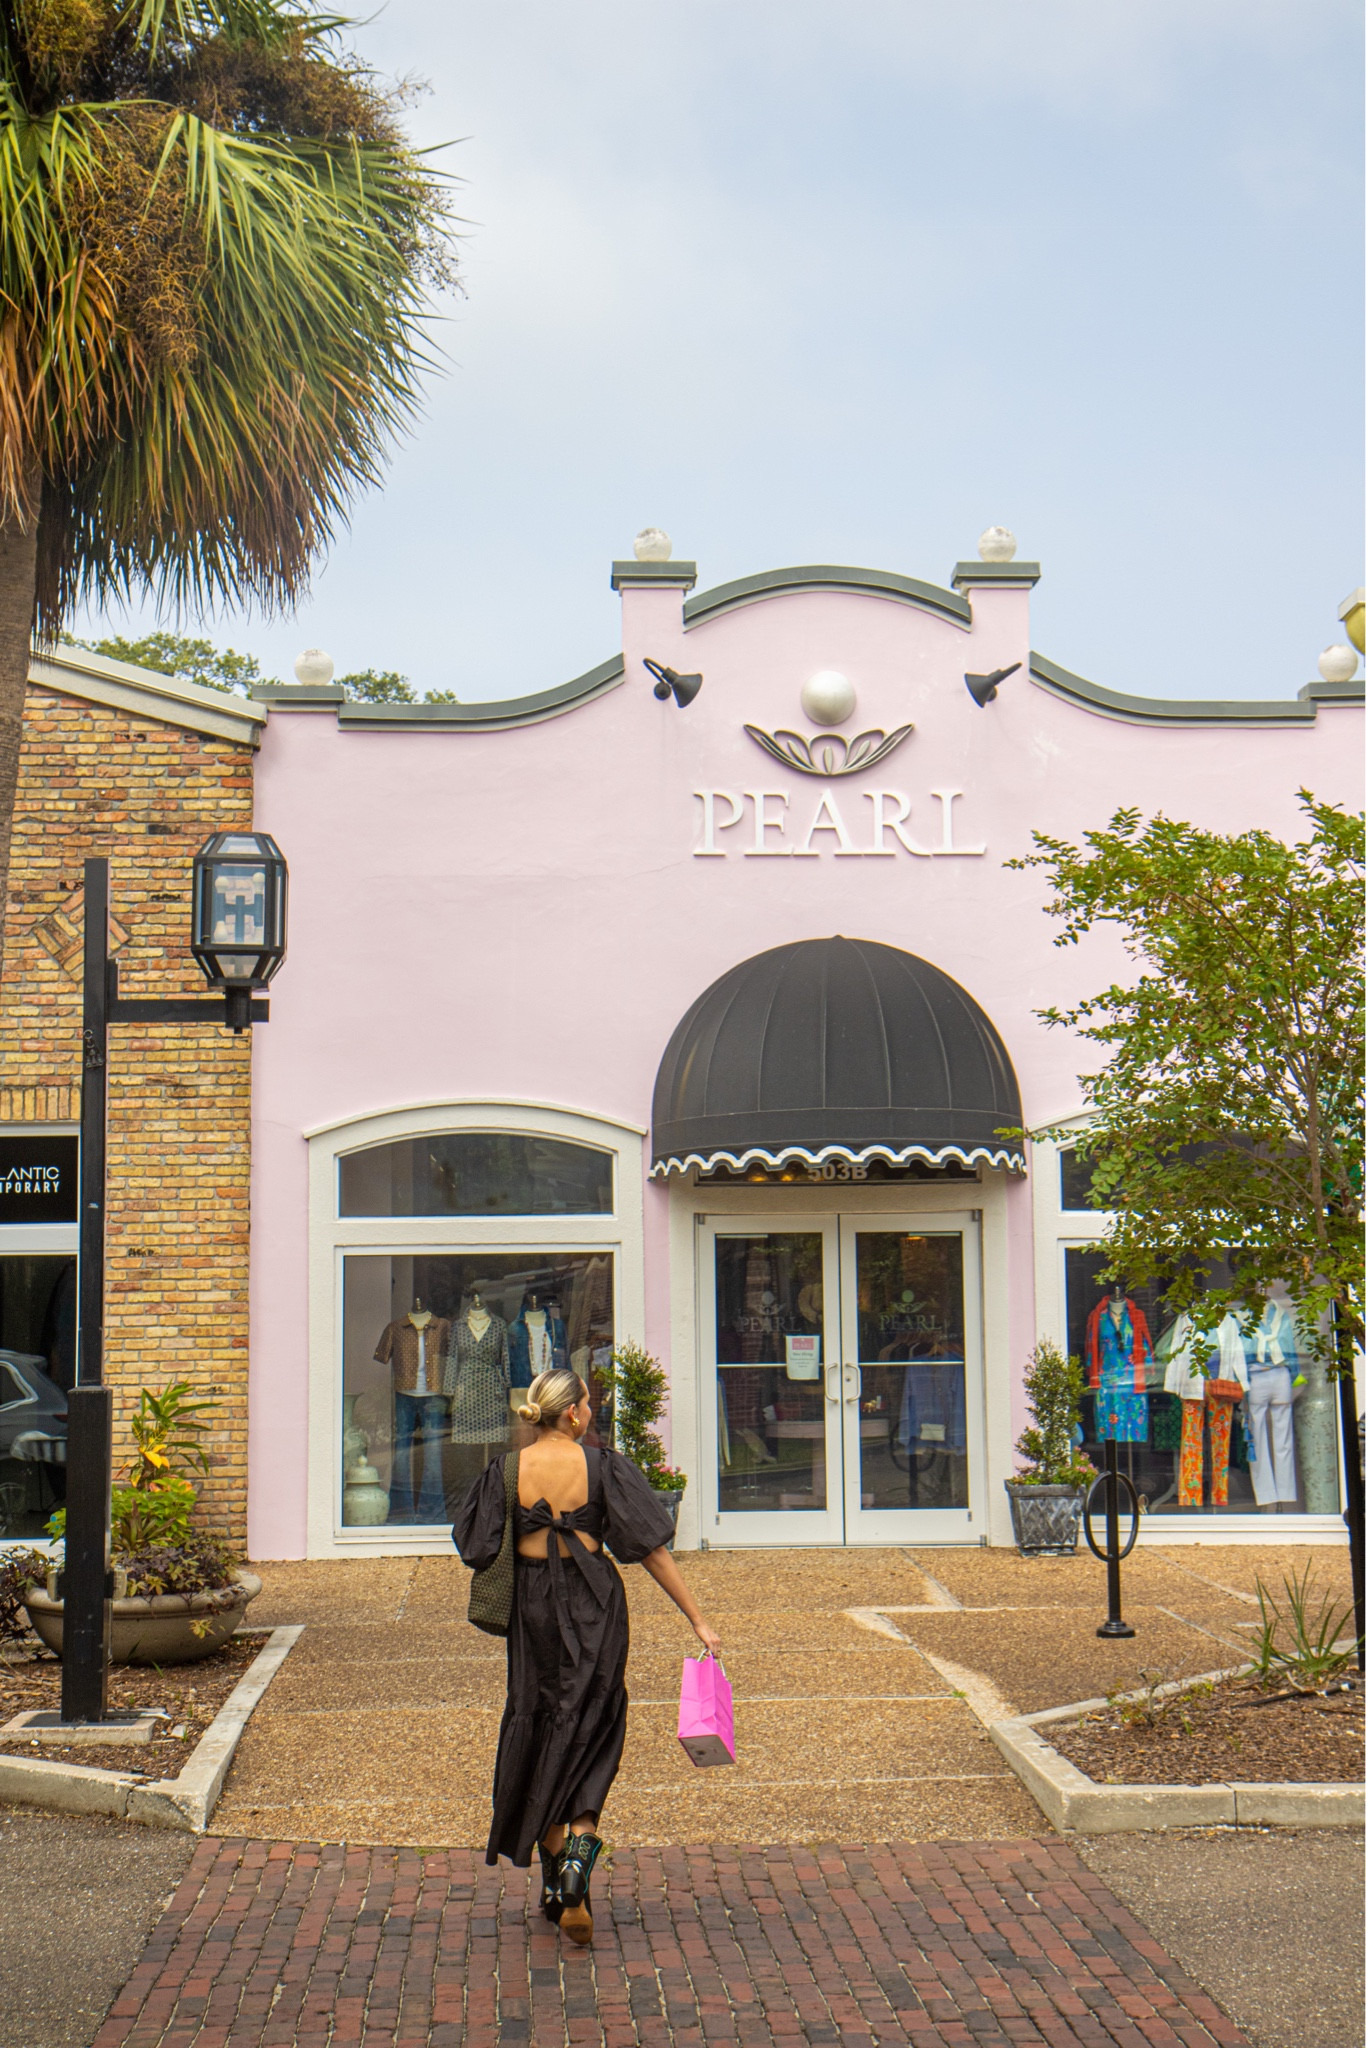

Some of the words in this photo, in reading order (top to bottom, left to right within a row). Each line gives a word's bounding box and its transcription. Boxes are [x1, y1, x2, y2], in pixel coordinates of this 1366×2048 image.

[692, 788, 987, 856] PEARL
[808, 1163, 868, 1180] 503B
[0, 1181, 60, 1194] PORARY
[737, 1316, 801, 1332] PEARL
[879, 1314, 942, 1331] PEARL
